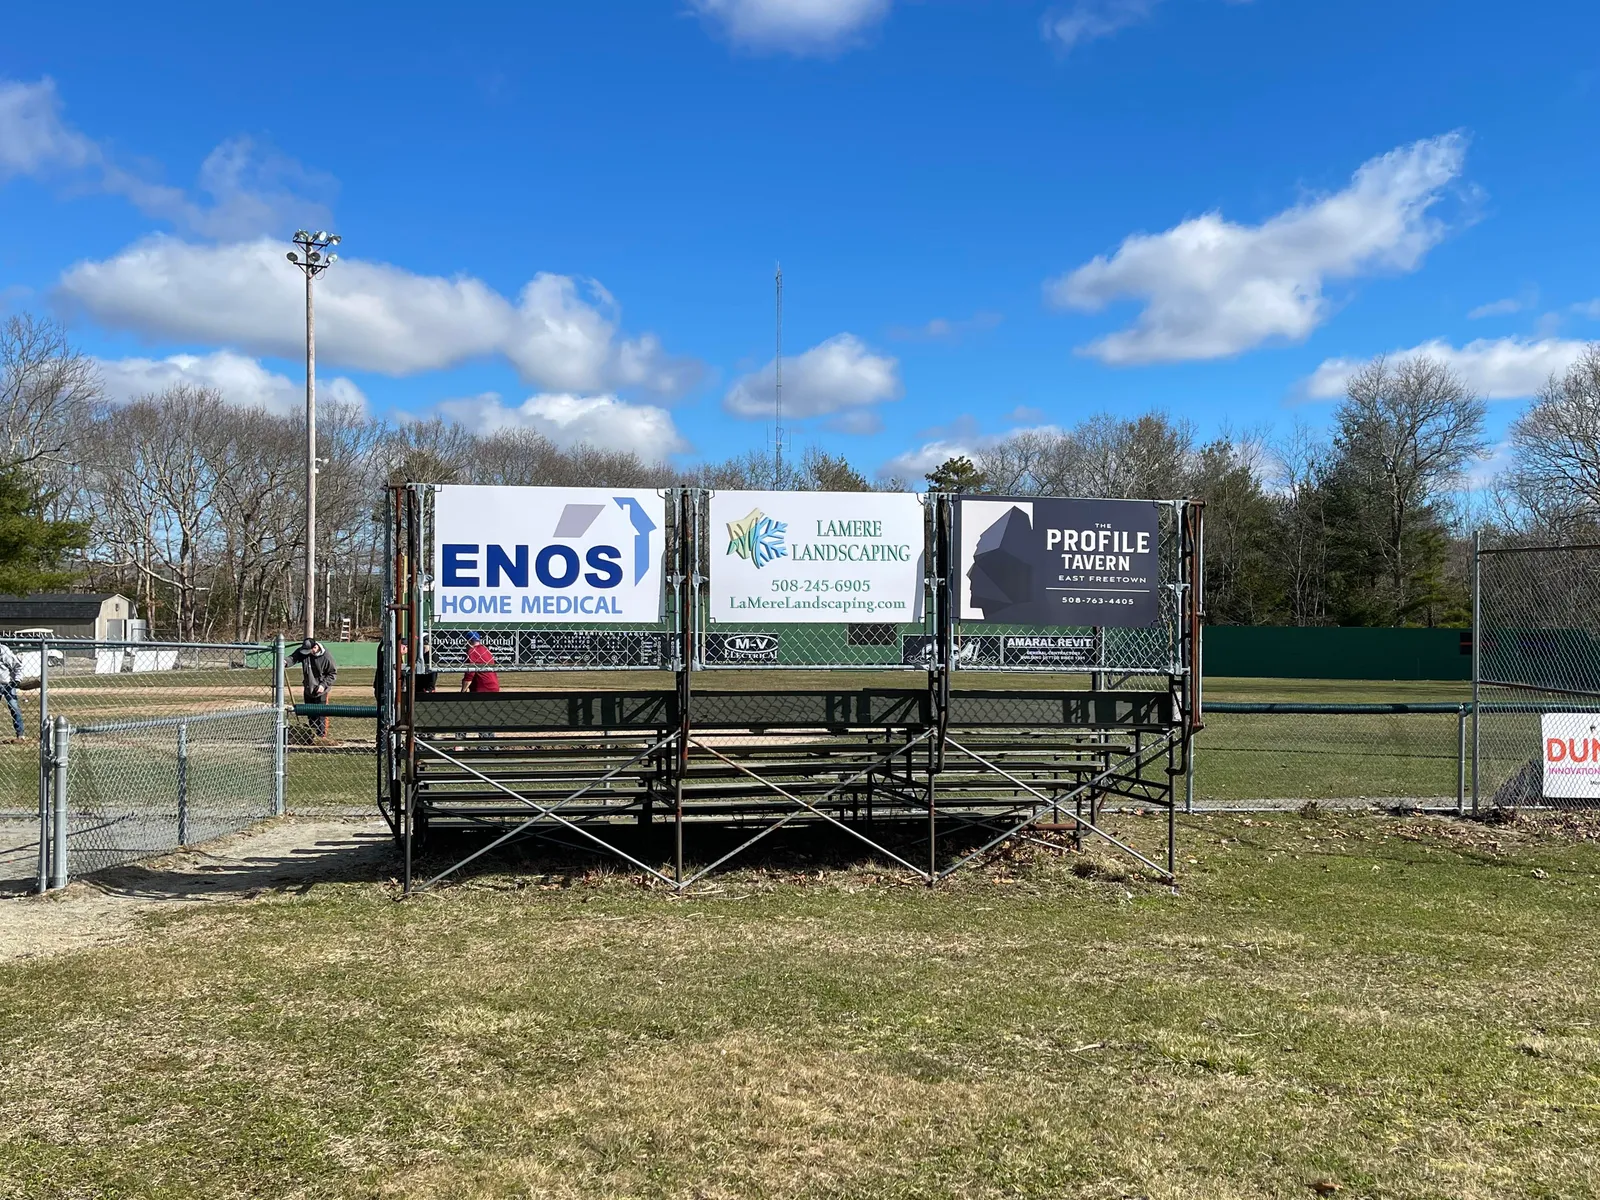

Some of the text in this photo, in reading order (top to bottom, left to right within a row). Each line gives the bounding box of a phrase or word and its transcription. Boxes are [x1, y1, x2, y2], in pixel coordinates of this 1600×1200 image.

[816, 520, 882, 537] LAMERE
[1046, 529, 1150, 553] PROFILE
[792, 544, 911, 561] LANDSCAPING
[442, 544, 623, 589] ENOS
[1061, 554, 1130, 571] TAVERN
[771, 580, 870, 592] 508-245-6905
[442, 596, 622, 614] HOME MEDICAL
[730, 596, 906, 612] LaMereLandscaping.com
[736, 638, 768, 649] M-V
[1007, 638, 1093, 646] AMARAL REVIT
[724, 649, 778, 658] ELECTRICAL
